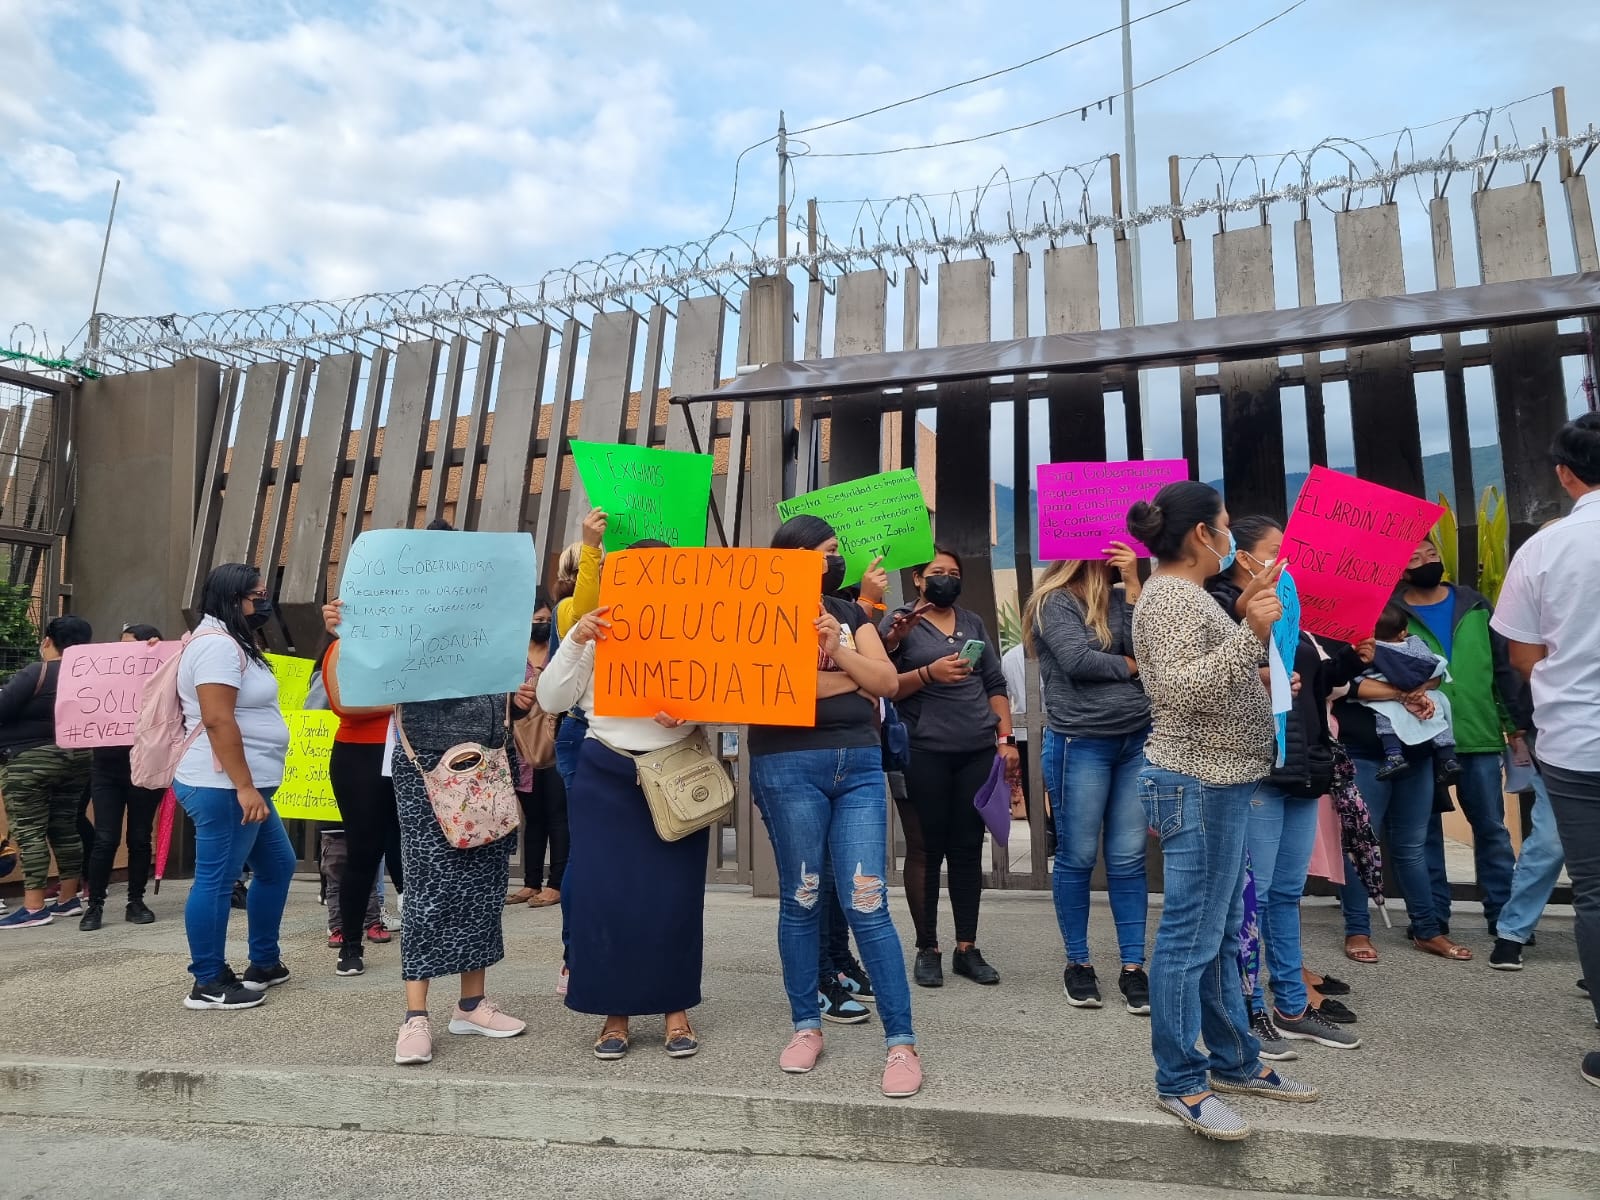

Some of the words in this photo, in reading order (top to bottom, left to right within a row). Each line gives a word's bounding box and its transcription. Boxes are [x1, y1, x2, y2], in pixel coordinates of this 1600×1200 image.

[780, 497, 822, 519] Nuestra
[826, 484, 872, 503] Seguridad
[873, 482, 883, 490] es
[846, 504, 864, 515] que
[867, 501, 880, 509] se
[1043, 503, 1073, 517] para
[855, 519, 866, 527] de
[914, 504, 925, 512] en
[1042, 516, 1059, 528] de
[1379, 512, 1401, 538] DE
[840, 532, 883, 555] Rosaura
[1287, 537, 1333, 574] JOSE
[349, 540, 387, 577] Sra
[613, 553, 785, 595] EXIGIMOS
[364, 605, 396, 618] MURO
[611, 600, 799, 645] SOLUCION
[350, 625, 369, 639] EL
[408, 624, 490, 659] ROSAURA
[400, 653, 465, 673] ZAPATA
[607, 659, 797, 707] INMEDIATA
